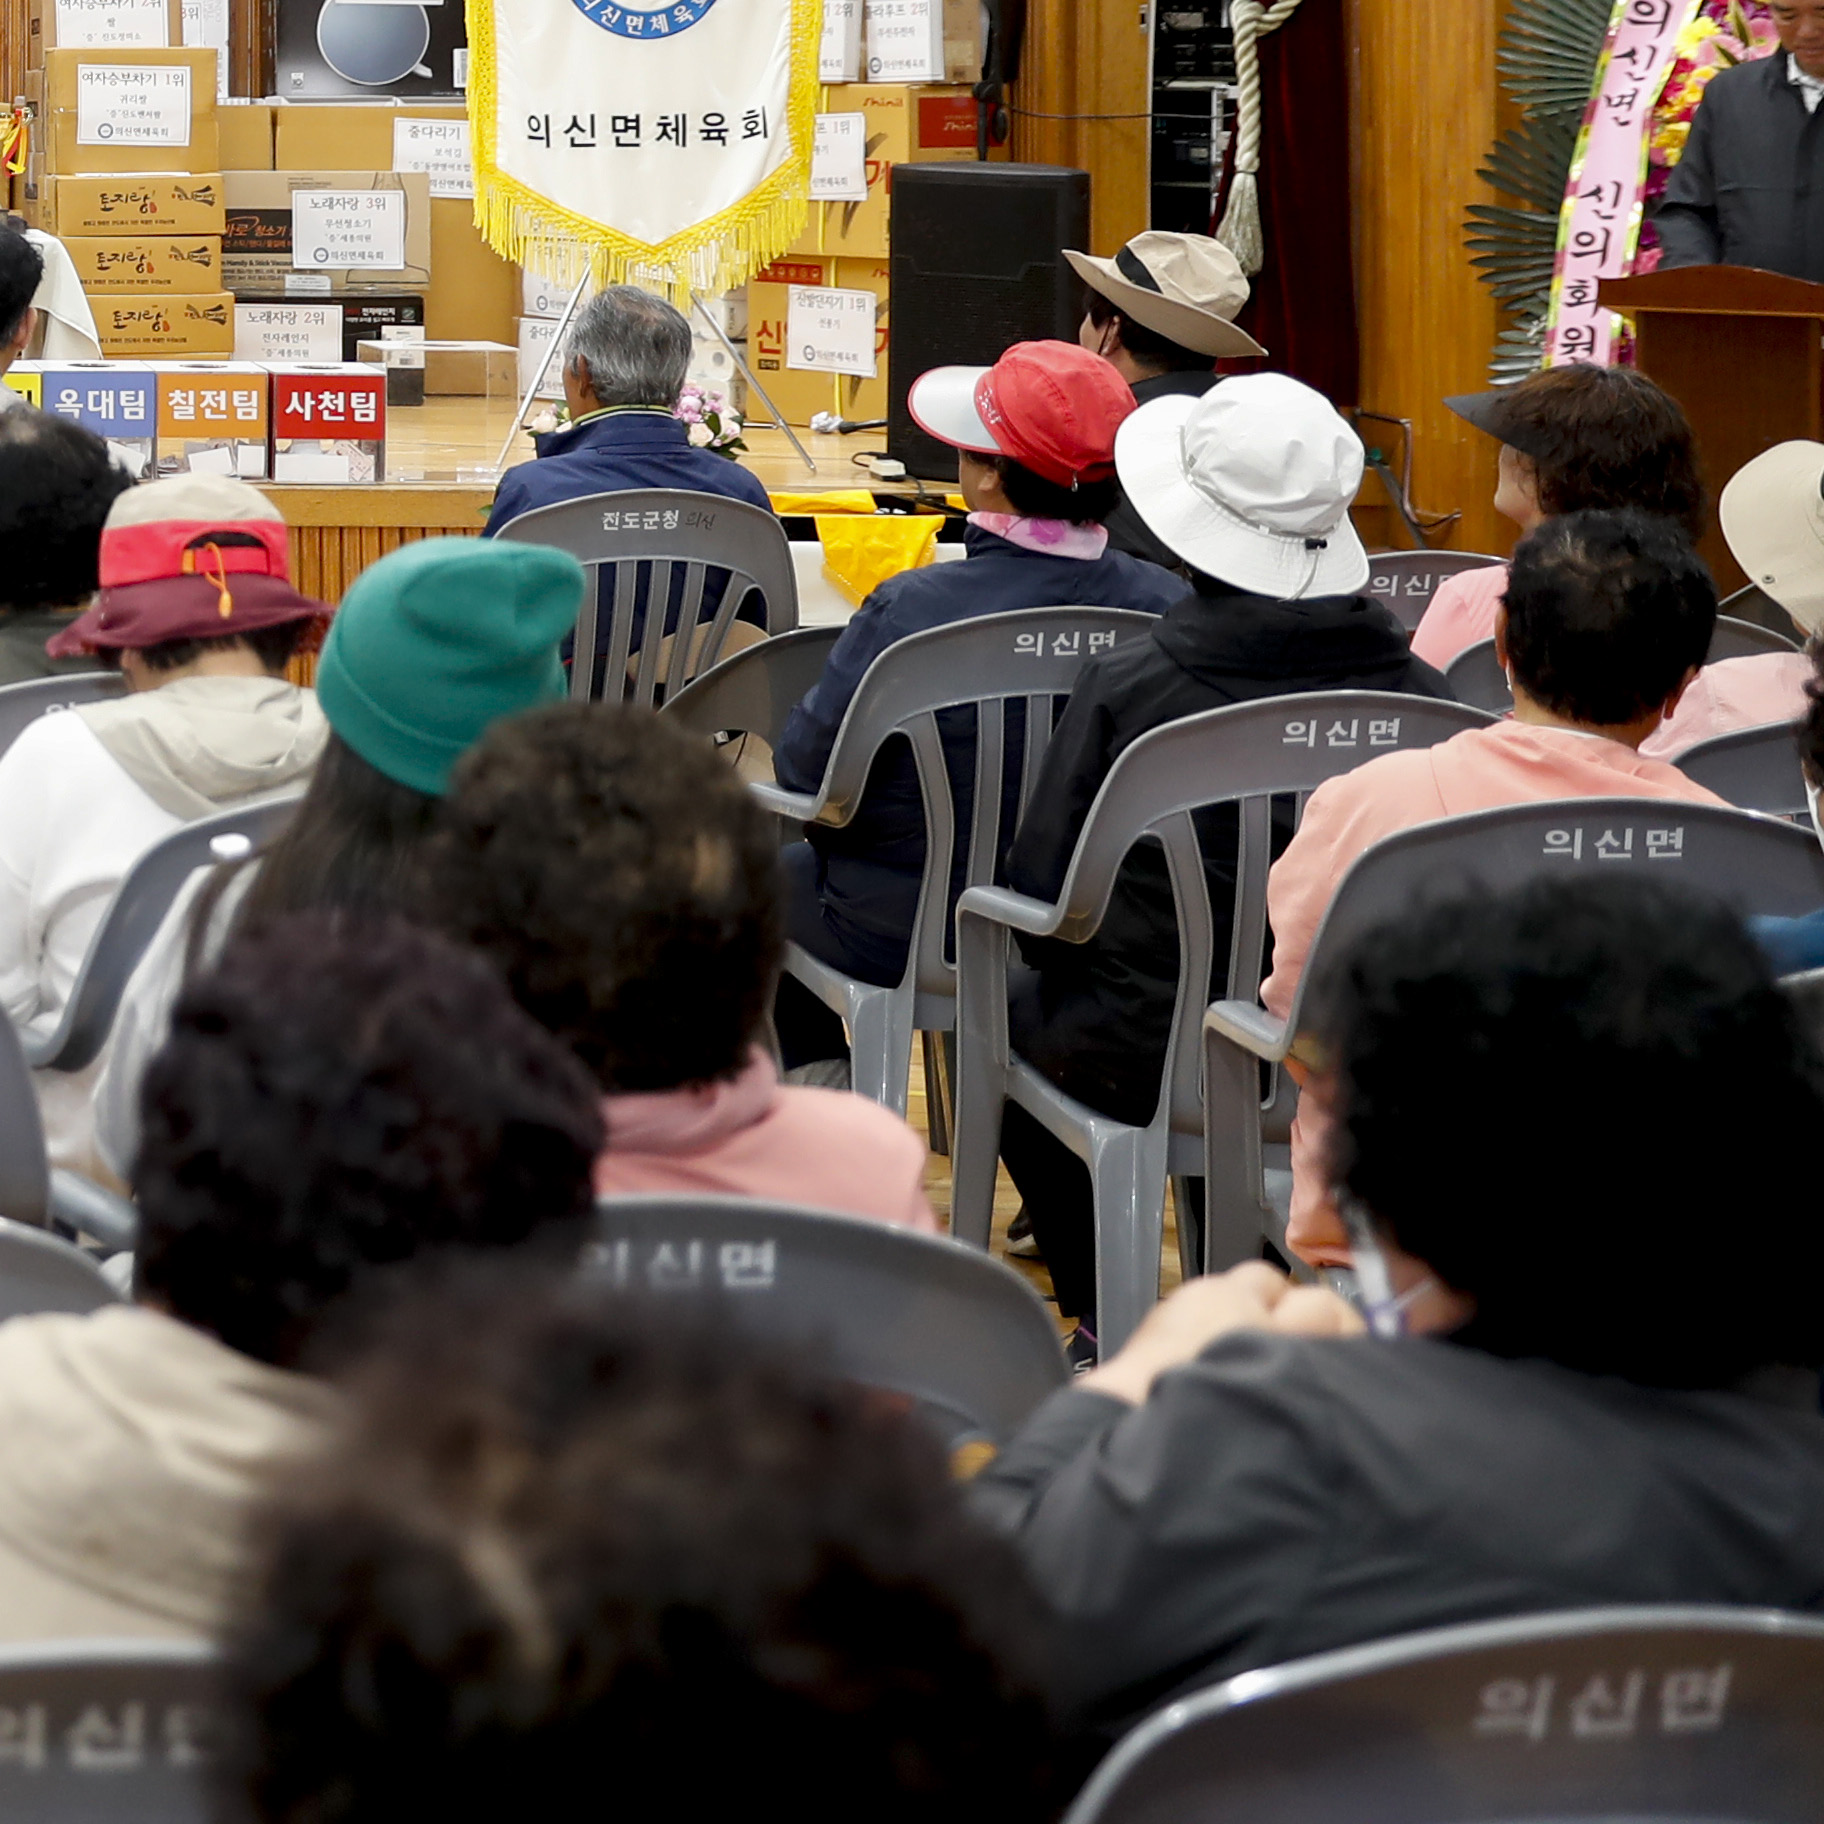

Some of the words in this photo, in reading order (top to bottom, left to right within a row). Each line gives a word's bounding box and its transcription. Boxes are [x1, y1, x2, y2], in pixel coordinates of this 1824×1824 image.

[81, 71, 158, 87] 여자승부차기
[165, 73, 185, 87] 1위
[408, 125, 461, 141] 줄다리기
[525, 107, 771, 149] 의신면체육회
[308, 197, 360, 211] 노래자랑
[365, 197, 387, 211] 3위
[246, 311, 298, 326] 노래자랑
[303, 311, 325, 325] 2위
[54, 388, 148, 422] 옥대팀
[166, 388, 261, 423] 칠전팀
[283, 390, 378, 424] 사천팀
[602, 509, 680, 532] 진도군청
[1013, 630, 1118, 658] 의신면
[1281, 717, 1402, 750] 의신면
[1541, 827, 1685, 862] 의신면
[1474, 1669, 1730, 1739] 의신면
